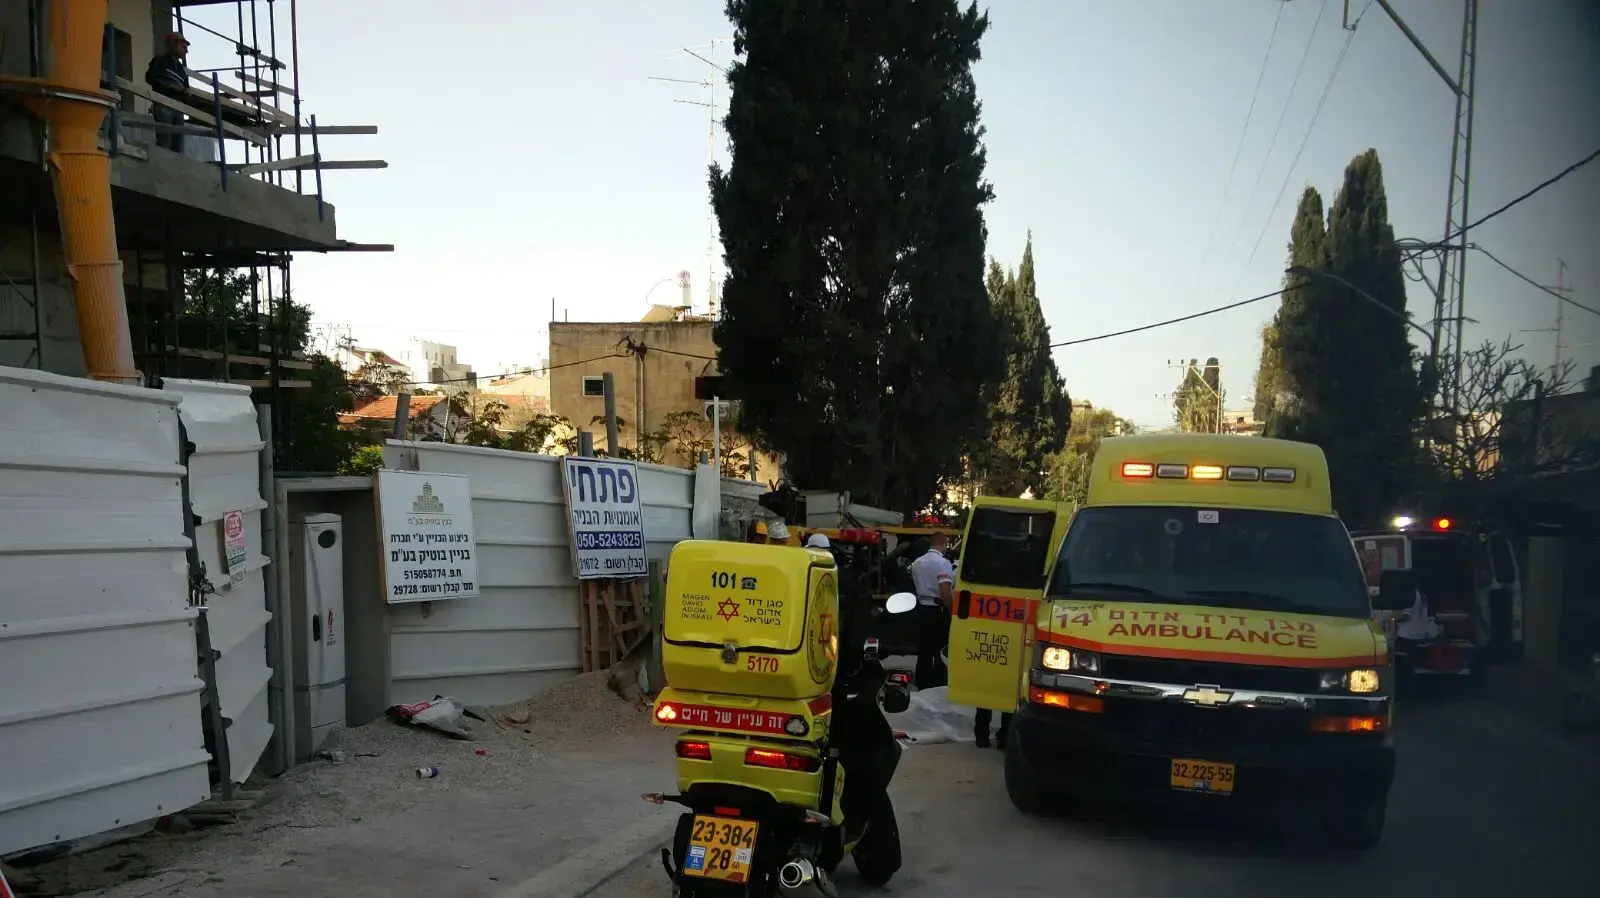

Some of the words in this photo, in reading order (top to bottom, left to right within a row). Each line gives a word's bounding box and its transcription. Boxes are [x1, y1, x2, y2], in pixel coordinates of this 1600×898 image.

[570, 465, 635, 503] פתחי
[574, 510, 599, 525] הבניה
[391, 534, 411, 543] חברת
[425, 534, 447, 544] הבניין
[449, 534, 468, 542] ביצוע
[577, 533, 640, 548] 050-5243825
[391, 549, 416, 562] בע"מ
[419, 550, 447, 564] בוטיק
[449, 549, 470, 563] בניין
[604, 558, 626, 569] רשום:
[628, 555, 643, 571] קבלן
[404, 569, 446, 579] 515058774
[712, 571, 737, 589] 101
[393, 584, 418, 595] 29728
[420, 584, 441, 593] רשום:
[443, 582, 459, 594] קבלן
[745, 598, 762, 606] דוד
[766, 600, 783, 608] מגן
[976, 598, 1012, 618] 101
[757, 608, 781, 616] אדום
[1109, 609, 1179, 622] אדום
[744, 615, 781, 625] בישראל
[1056, 612, 1092, 628] 14
[1195, 613, 1247, 625] דוד
[1265, 618, 1316, 633] מגן
[971, 631, 988, 641] דוד
[993, 633, 1009, 645] מגן
[1108, 623, 1317, 649] AMBULANCE
[980, 643, 1007, 655] אדום
[966, 649, 1007, 665] בישראל
[747, 655, 778, 673] 5170
[715, 709, 732, 724] של
[737, 712, 763, 727] עניין
[769, 716, 783, 729] זה
[708, 847, 731, 870] 28
